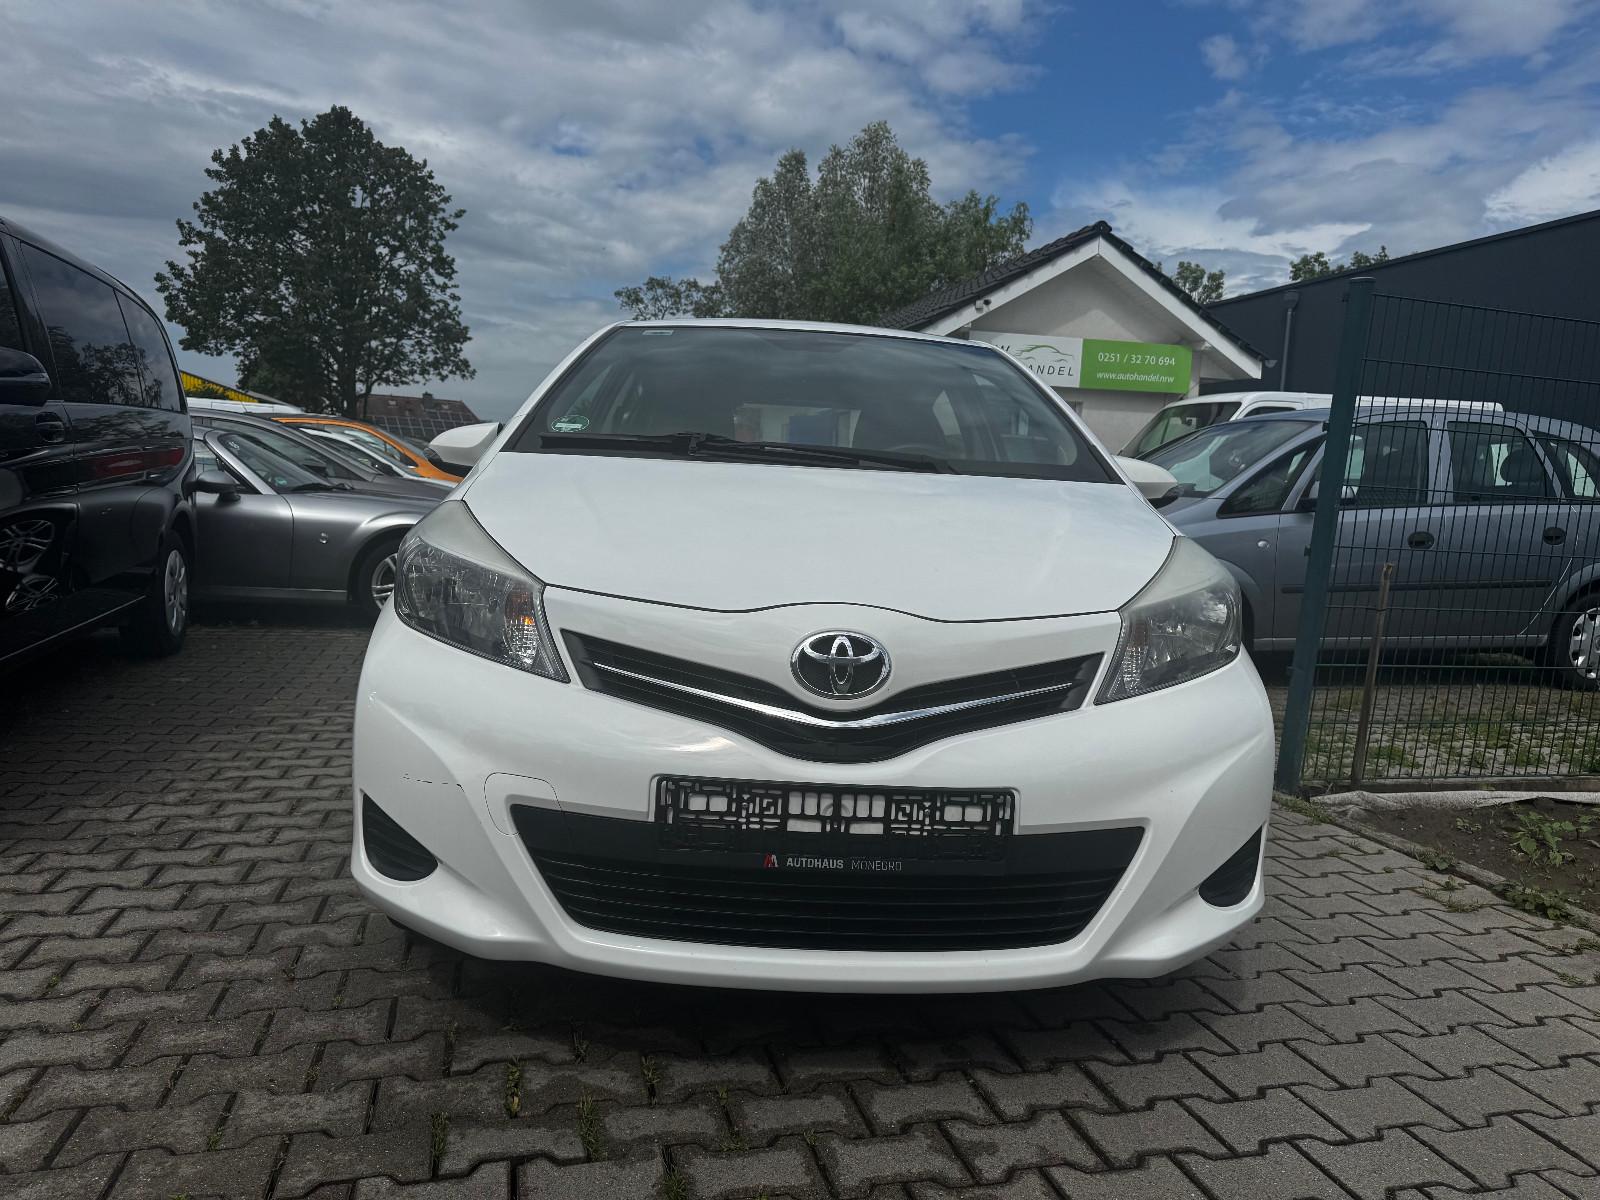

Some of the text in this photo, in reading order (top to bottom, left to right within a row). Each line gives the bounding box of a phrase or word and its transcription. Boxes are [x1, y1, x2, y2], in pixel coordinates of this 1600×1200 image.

[1098, 352, 1120, 363] 0251
[1130, 354, 1142, 364] 32
[1144, 355, 1156, 365] 70
[1158, 356, 1176, 366] 694
[1096, 372, 1175, 383] www.autohandel.nrw
[786, 857, 844, 869] AUTOHAUS
[851, 860, 903, 871] MONEGRO
